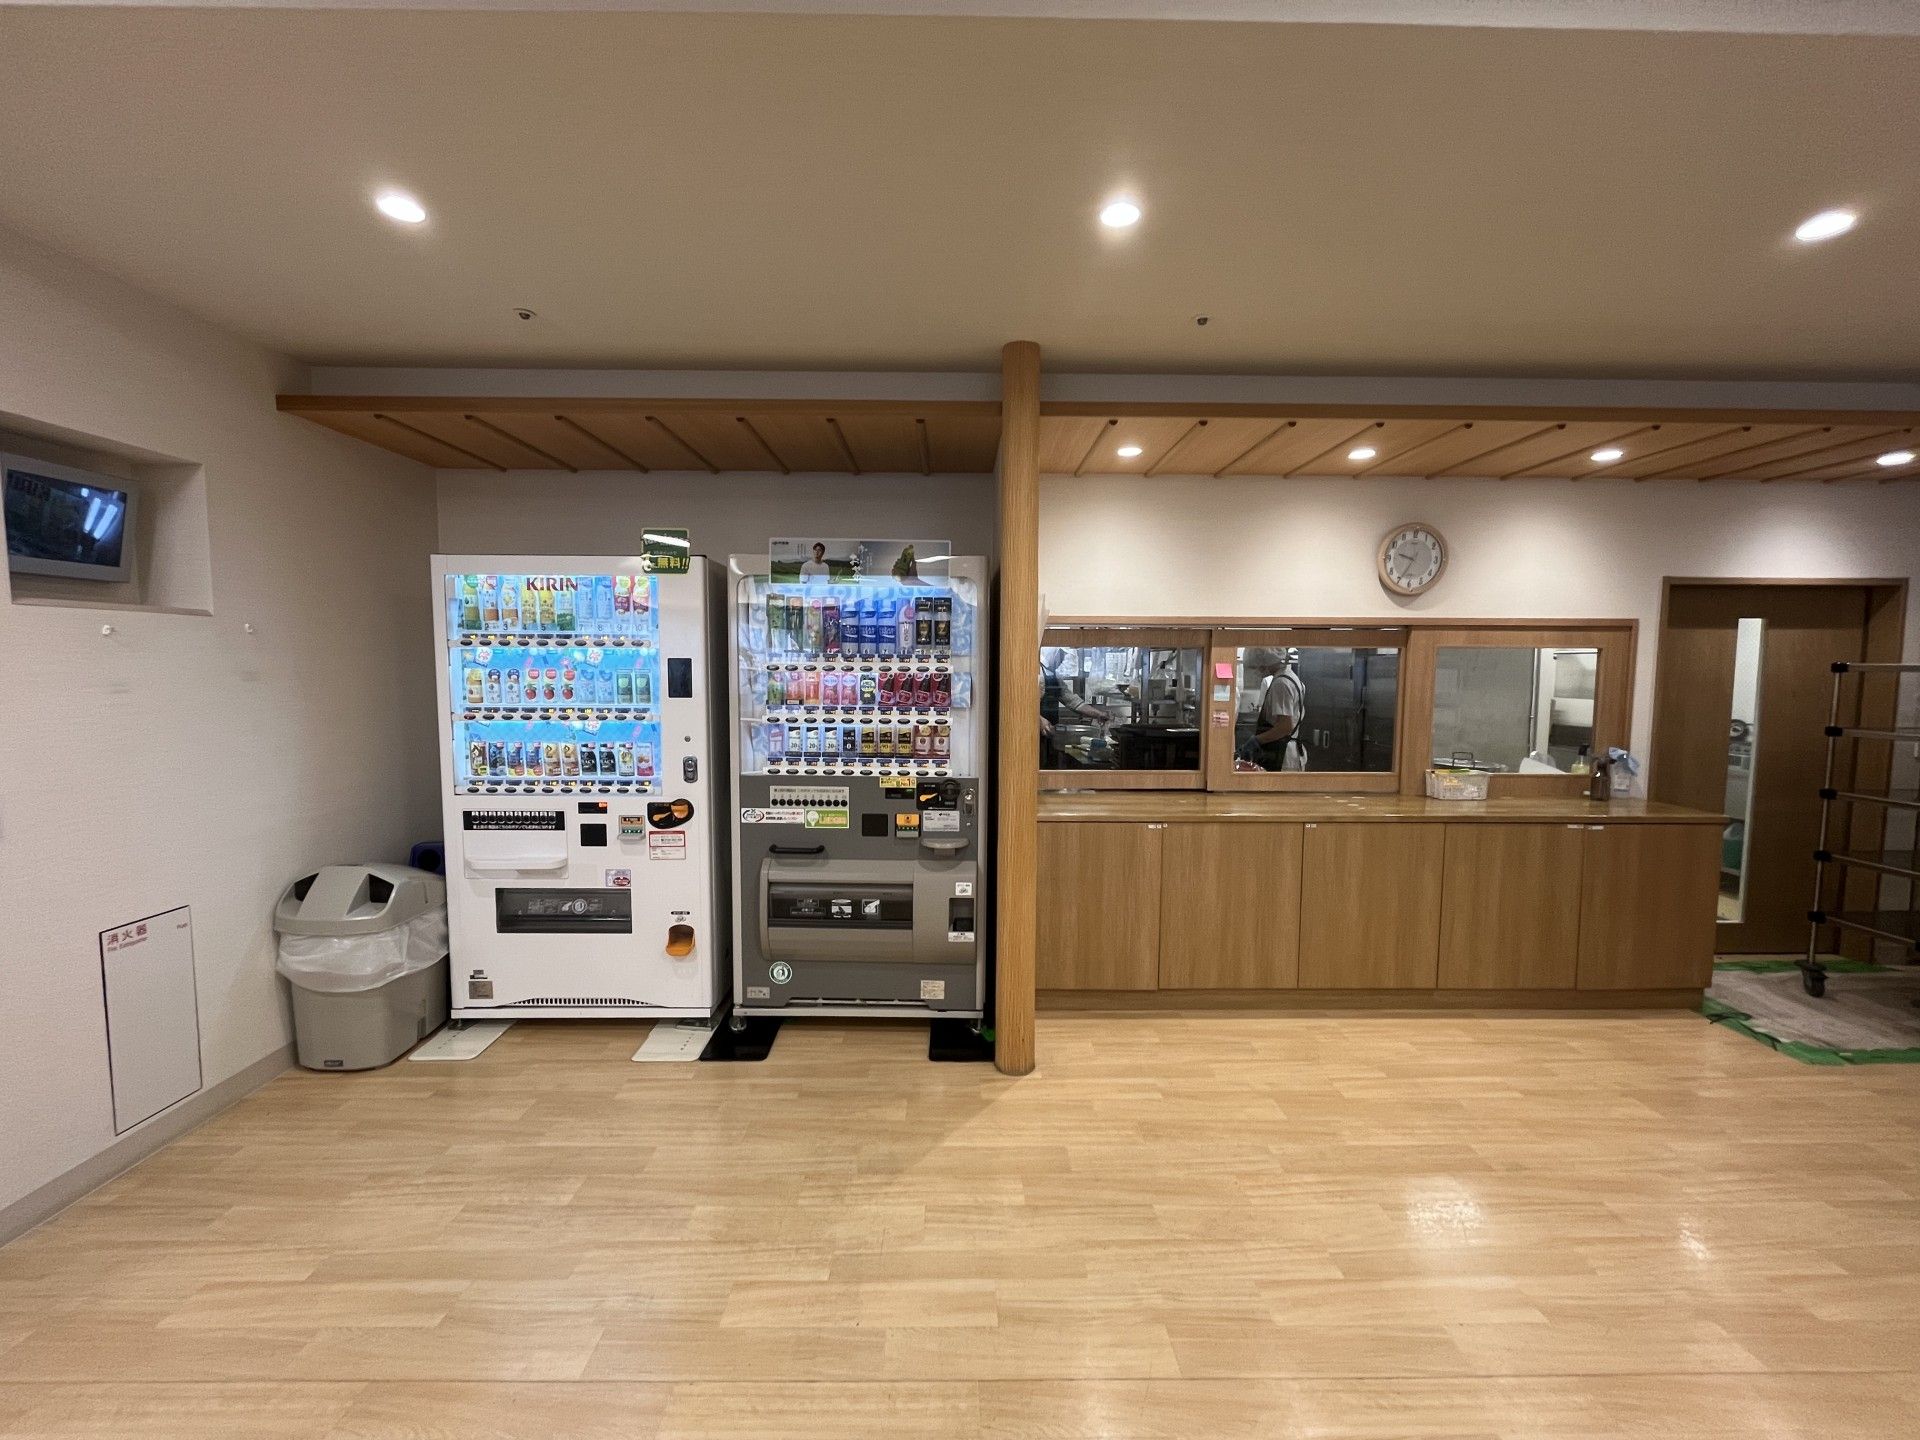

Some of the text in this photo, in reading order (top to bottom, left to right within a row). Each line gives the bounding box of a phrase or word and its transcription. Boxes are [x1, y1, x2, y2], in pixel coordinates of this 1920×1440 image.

[1432, 542, 1436, 550] 2
[1434, 556, 1438, 564] 3
[526, 577, 579, 591] KIRIN
[1397, 576, 1402, 584] 7
[1407, 580, 1412, 588] 6
[107, 924, 148, 946] 消火器
